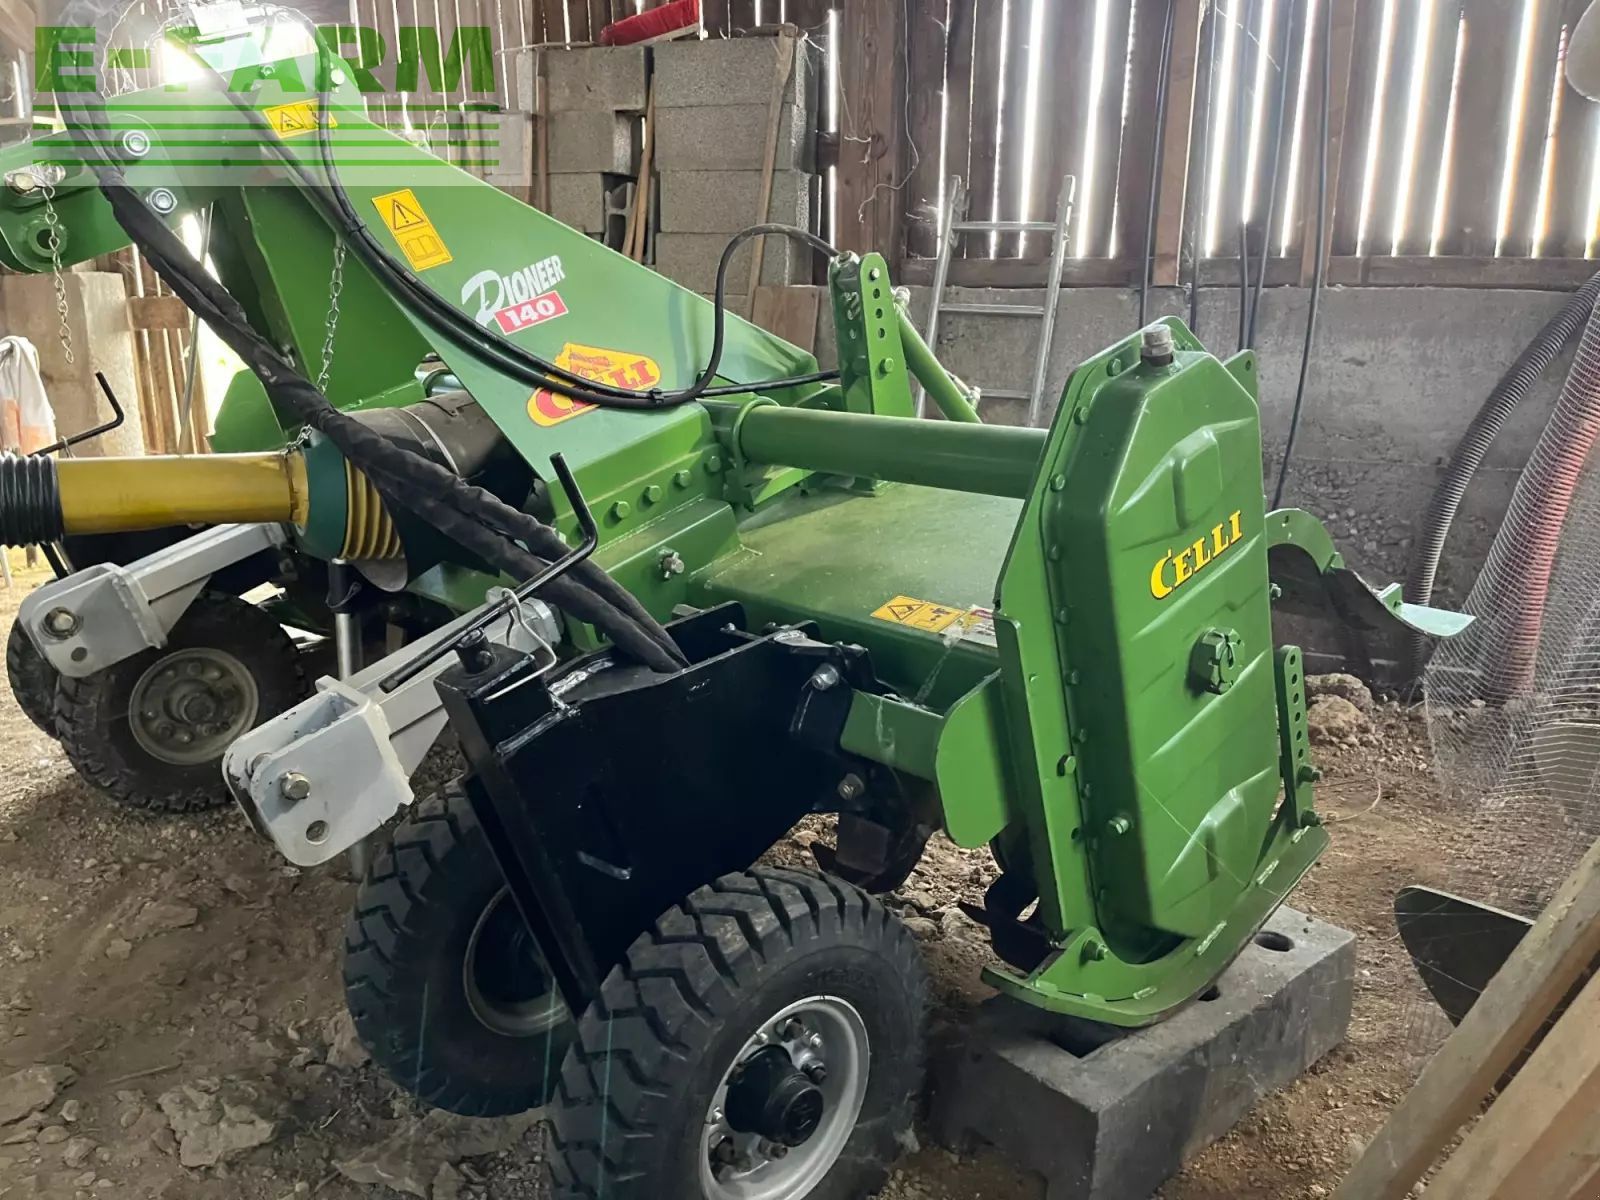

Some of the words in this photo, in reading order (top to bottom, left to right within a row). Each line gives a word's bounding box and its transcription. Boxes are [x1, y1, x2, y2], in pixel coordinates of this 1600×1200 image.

[504, 298, 557, 327] 140
[536, 360, 656, 419] CLI
[1150, 509, 1243, 600] CELLI
